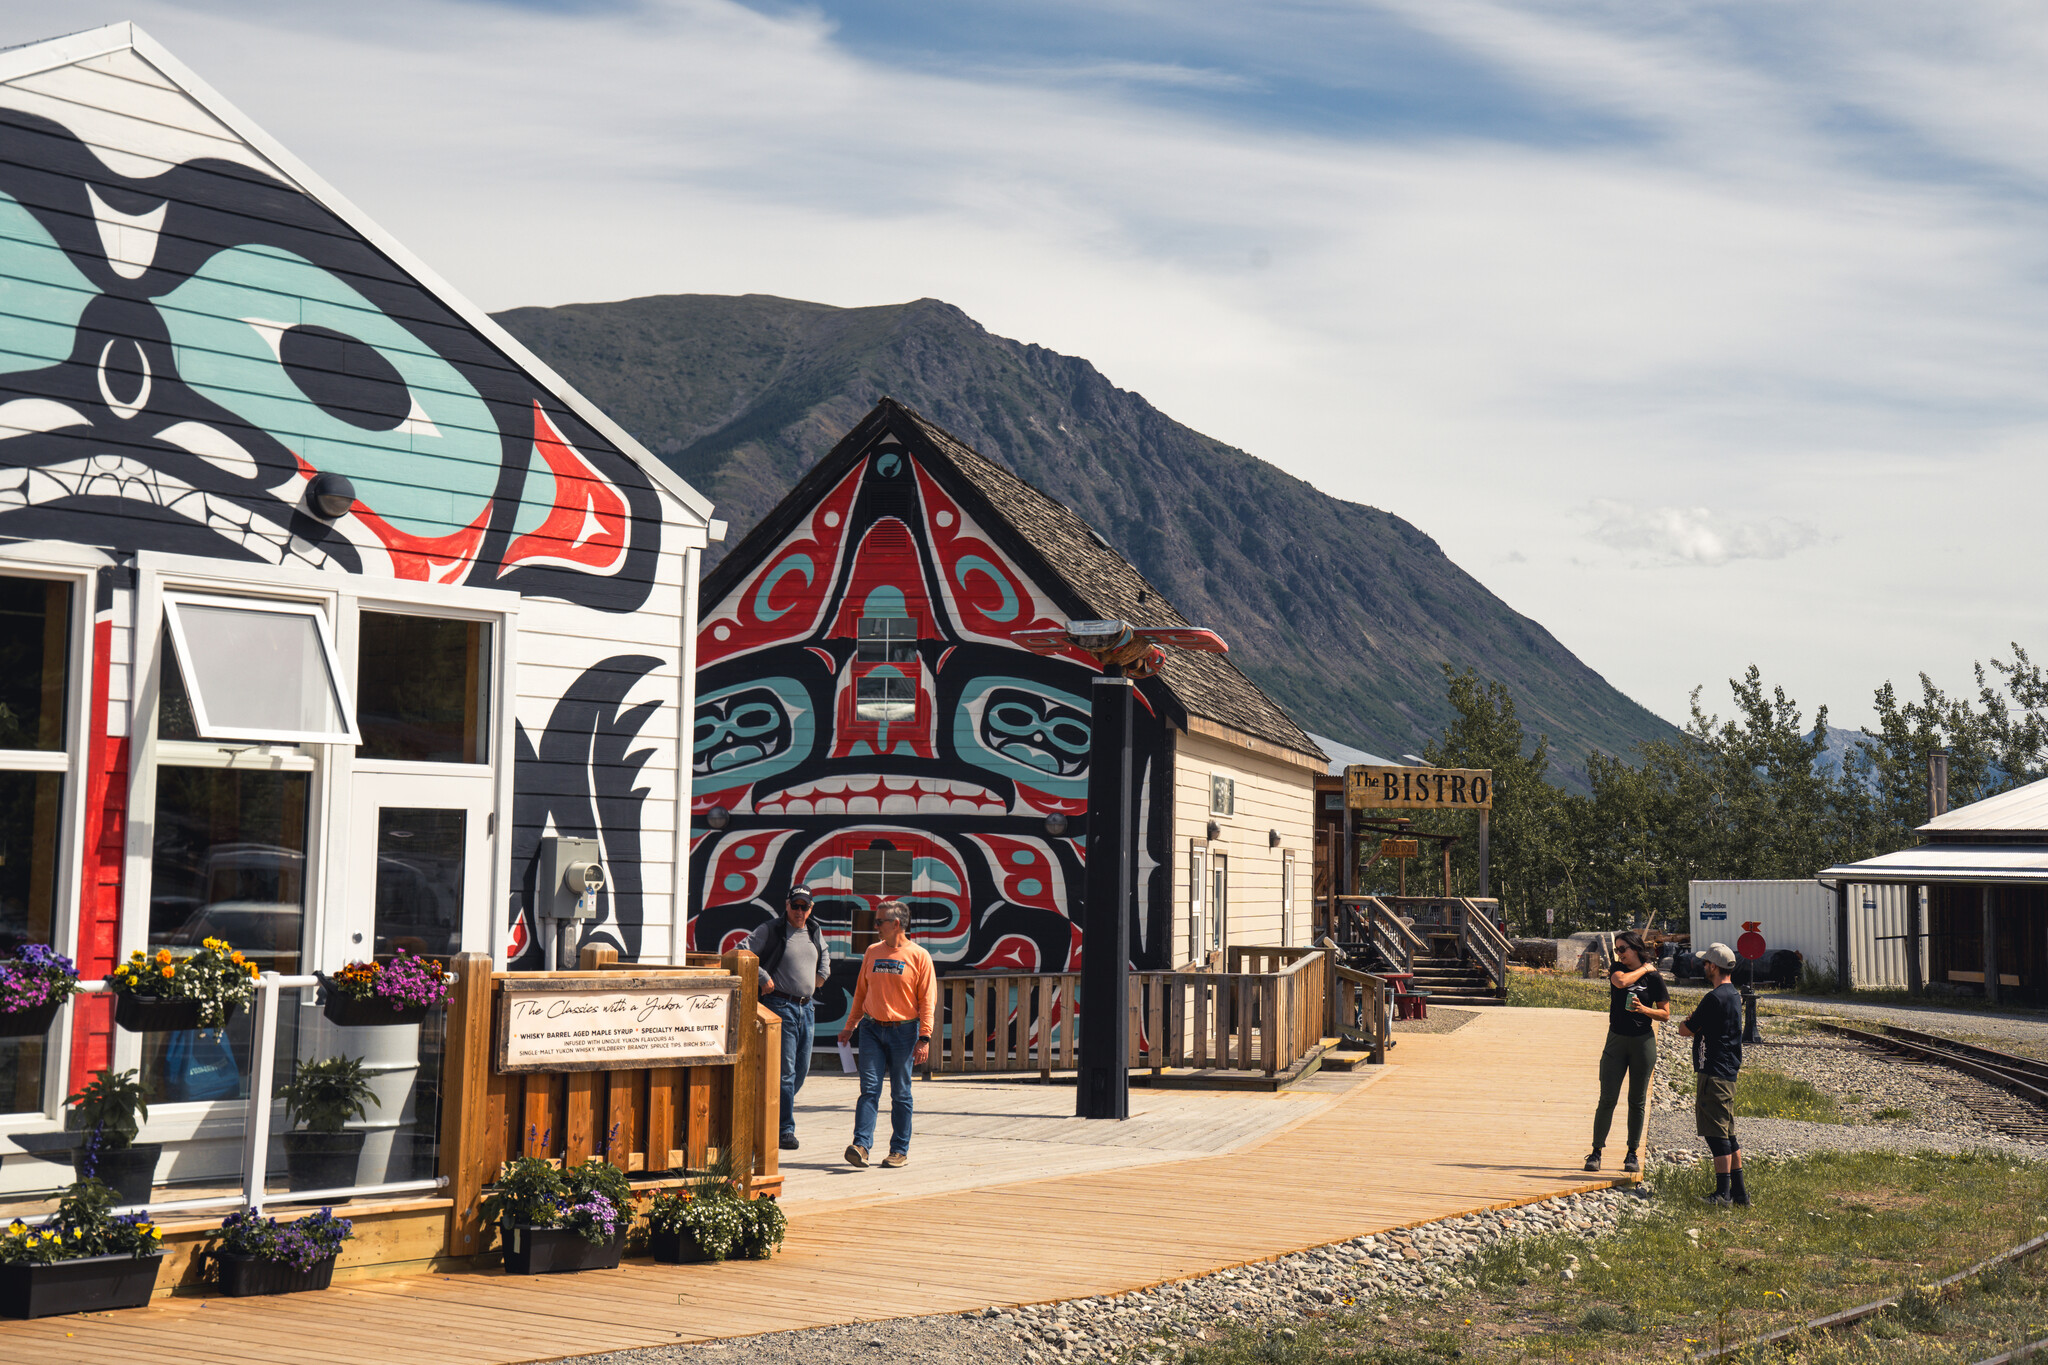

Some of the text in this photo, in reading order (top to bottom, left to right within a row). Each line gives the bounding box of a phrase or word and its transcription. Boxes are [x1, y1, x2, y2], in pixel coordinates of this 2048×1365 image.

[1354, 771, 1487, 804] The BISTRO
[514, 1000, 543, 1019] The
[547, 1000, 600, 1019] Classics
[602, 998, 627, 1013] with
[637, 997, 684, 1023] Yukon
[686, 994, 724, 1013] Twist
[546, 1031, 571, 1039] BARREL
[613, 1028, 634, 1036] SYRUP
[641, 1026, 673, 1034] SPECIALTY
[696, 1024, 719, 1032] BUTTER
[640, 1035, 667, 1043] FLAVOURS
[597, 1044, 626, 1052] WILDBERRY
[650, 1042, 669, 1050] SPRUCE
[683, 1040, 699, 1048] BIRCH
